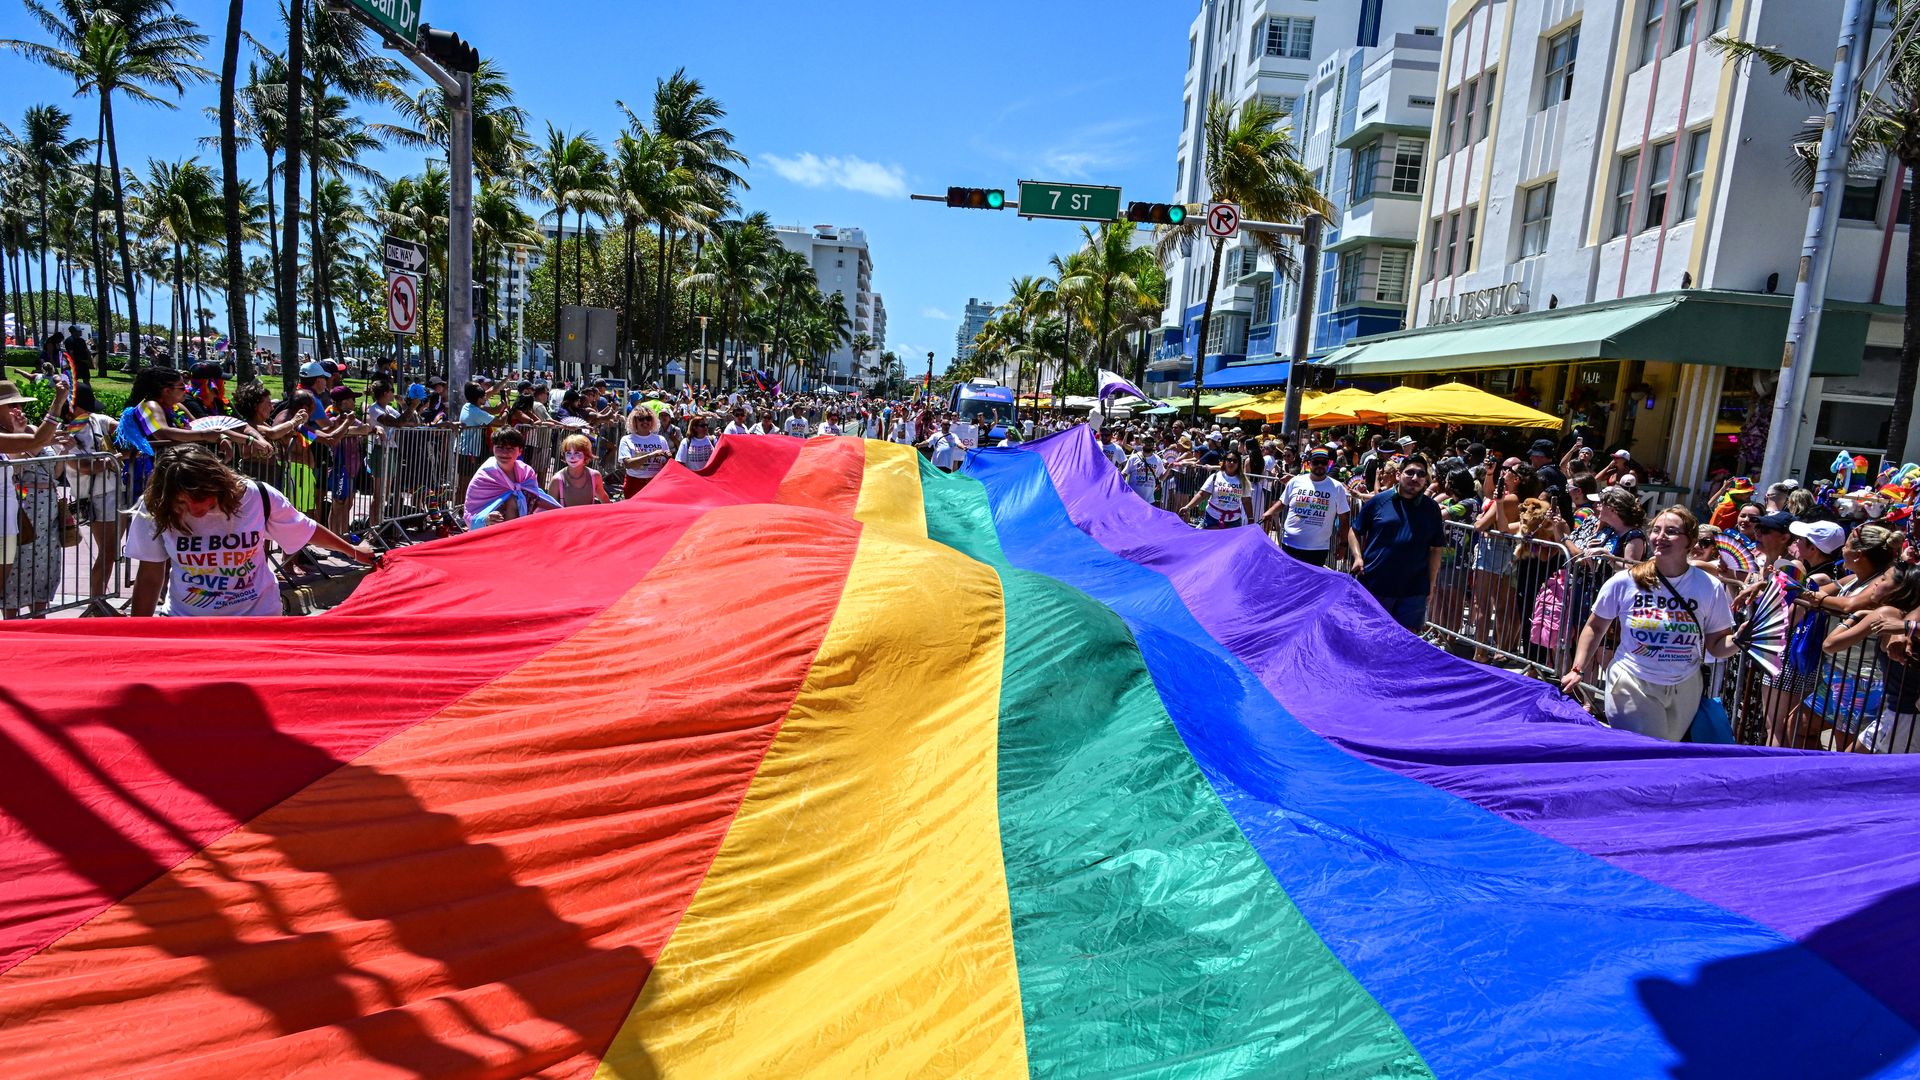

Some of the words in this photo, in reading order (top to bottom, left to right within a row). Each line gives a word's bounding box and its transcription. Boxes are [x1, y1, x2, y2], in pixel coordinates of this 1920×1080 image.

[400, 0, 416, 32] Dr
[1048, 190, 1062, 210] 7
[1070, 193, 1092, 211] ST
[387, 245, 399, 260] ONE
[400, 249, 413, 262] WAY
[1426, 281, 1522, 327] MAJESTIC
[1295, 495, 1310, 503] LIVE
[1311, 497, 1330, 505] FREE
[1308, 490, 1331, 499] BOLD
[1294, 507, 1312, 516] LOVE
[176, 536, 202, 552] BE
[208, 530, 260, 551] BOLD
[177, 552, 218, 567] LIVE
[218, 558, 256, 577] WOKE
[1633, 594, 1653, 608] BE
[1657, 596, 1698, 611] BOLD
[1632, 608, 1663, 620] LIVE
[1631, 618, 1660, 630] STAY
[1630, 628, 1670, 644] LOVE
[1672, 634, 1697, 646] ALL
